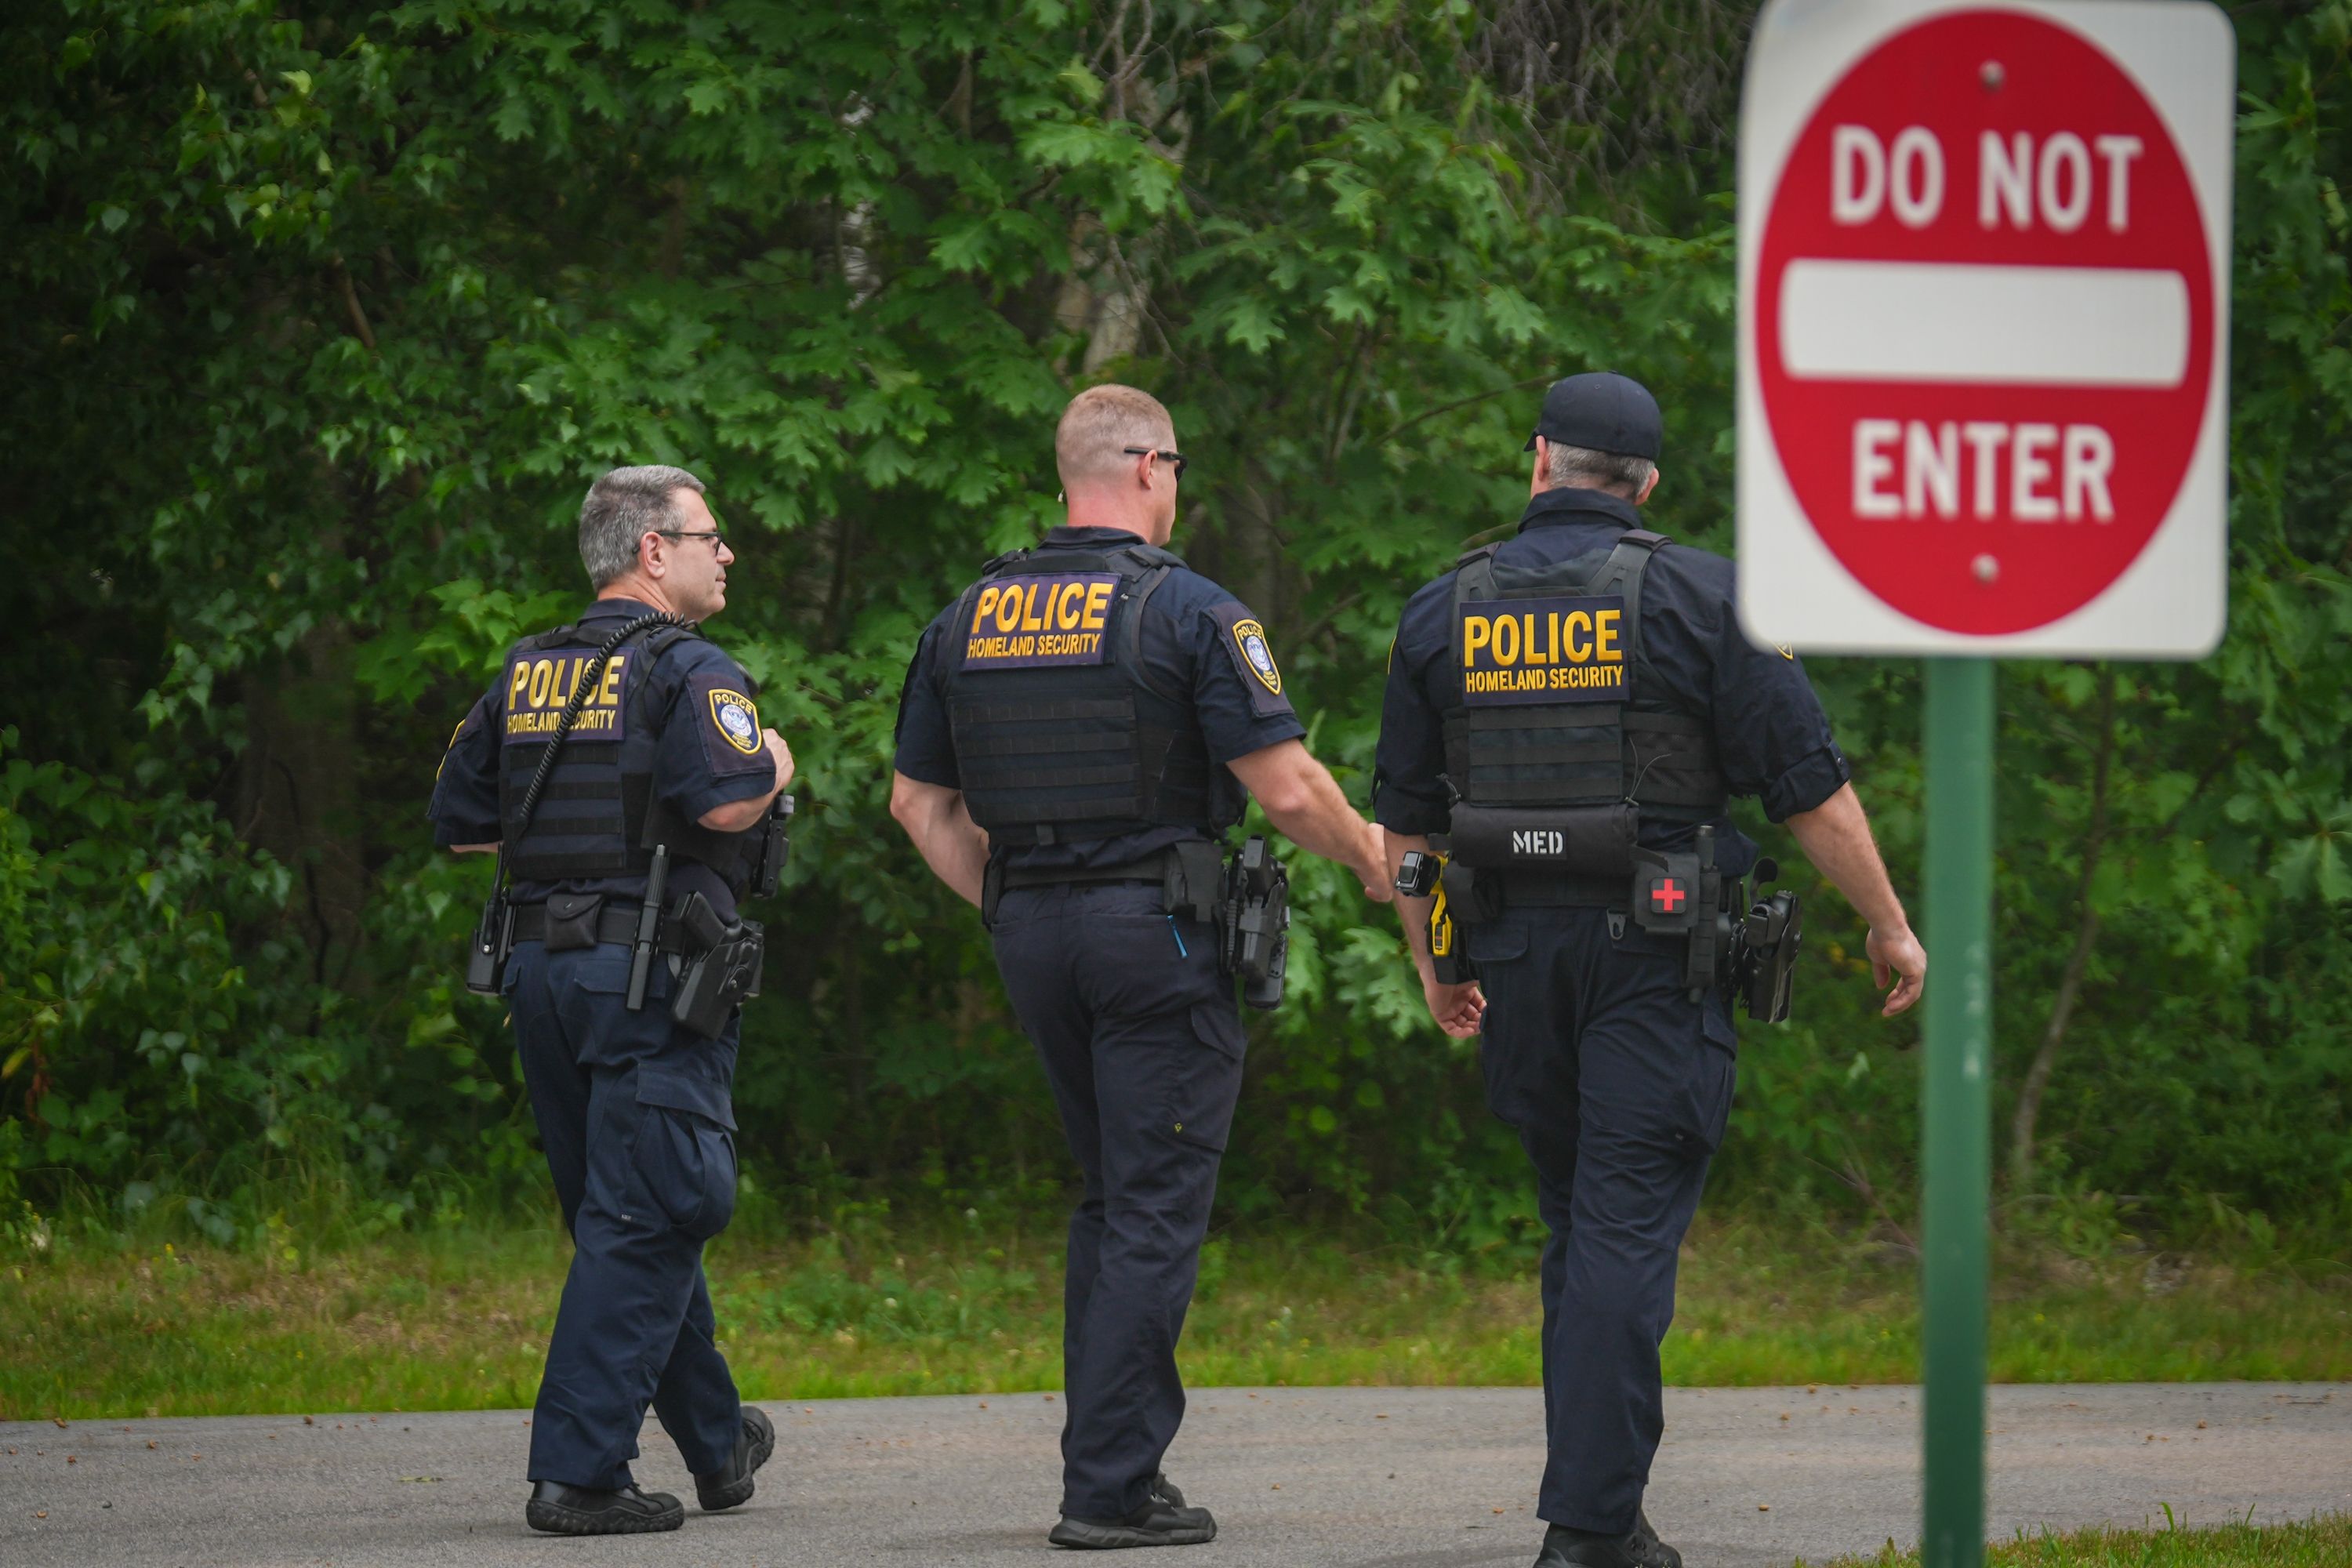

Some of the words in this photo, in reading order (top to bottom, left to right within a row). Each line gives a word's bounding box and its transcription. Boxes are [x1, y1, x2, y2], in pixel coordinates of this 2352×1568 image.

[1830, 123, 1947, 230] DO
[1977, 128, 2145, 234] NOT
[1852, 417, 2116, 523] ENTER
[971, 582, 1114, 634] POLICE
[967, 635, 1035, 659] HOMELAND
[1036, 633, 1101, 656] SECURITY
[1237, 625, 1262, 641] POLICE
[1464, 609, 1623, 667] POLICE
[508, 655, 625, 710] POLICE
[1465, 668, 1547, 693] HOMELAND
[1549, 665, 1624, 689] SECURITY
[714, 693, 753, 716] POLICE
[507, 711, 561, 735] HOMELAND
[1512, 830, 1563, 855] MED
